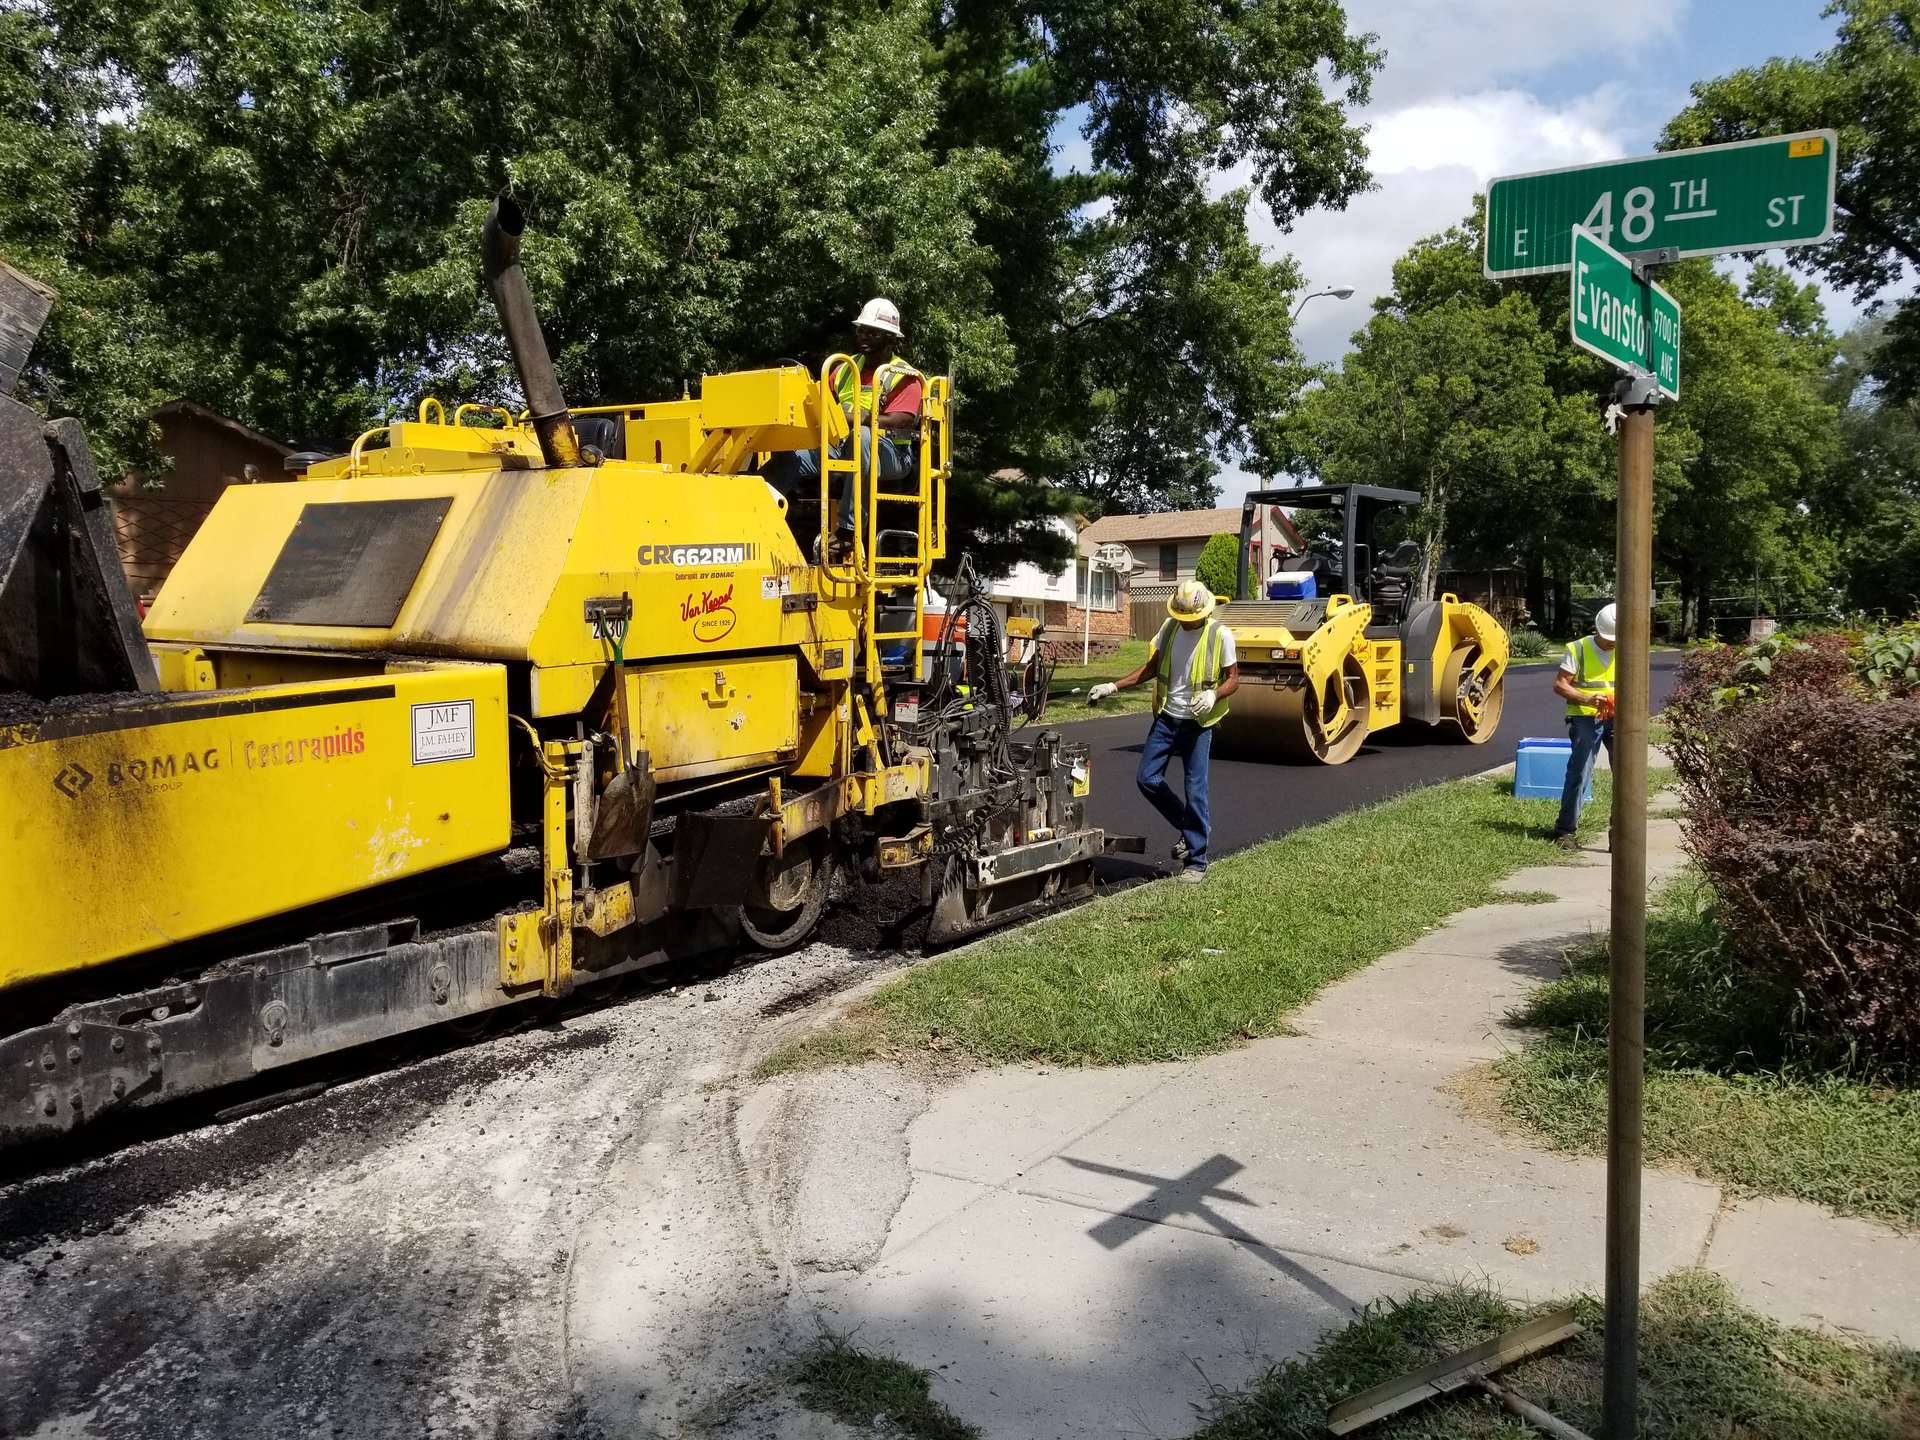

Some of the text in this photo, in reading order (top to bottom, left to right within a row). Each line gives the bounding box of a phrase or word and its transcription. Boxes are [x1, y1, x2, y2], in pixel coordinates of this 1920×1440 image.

[1515, 229, 1529, 256] E
[1766, 195, 1805, 227] ST
[1578, 260, 1653, 363] Evanston
[1654, 308, 1678, 349] 9700 E
[1661, 351, 1674, 383] AVE
[700, 572, 710, 580] BY
[711, 571, 735, 579] BOMAG
[680, 593, 701, 622] Van
[701, 583, 734, 614] Keppel
[701, 620, 719, 628] SINCE
[427, 707, 460, 730] JMF
[437, 731, 467, 745] FAHEY
[108, 748, 218, 786] BOMAG
[146, 781, 183, 794] GROUP
